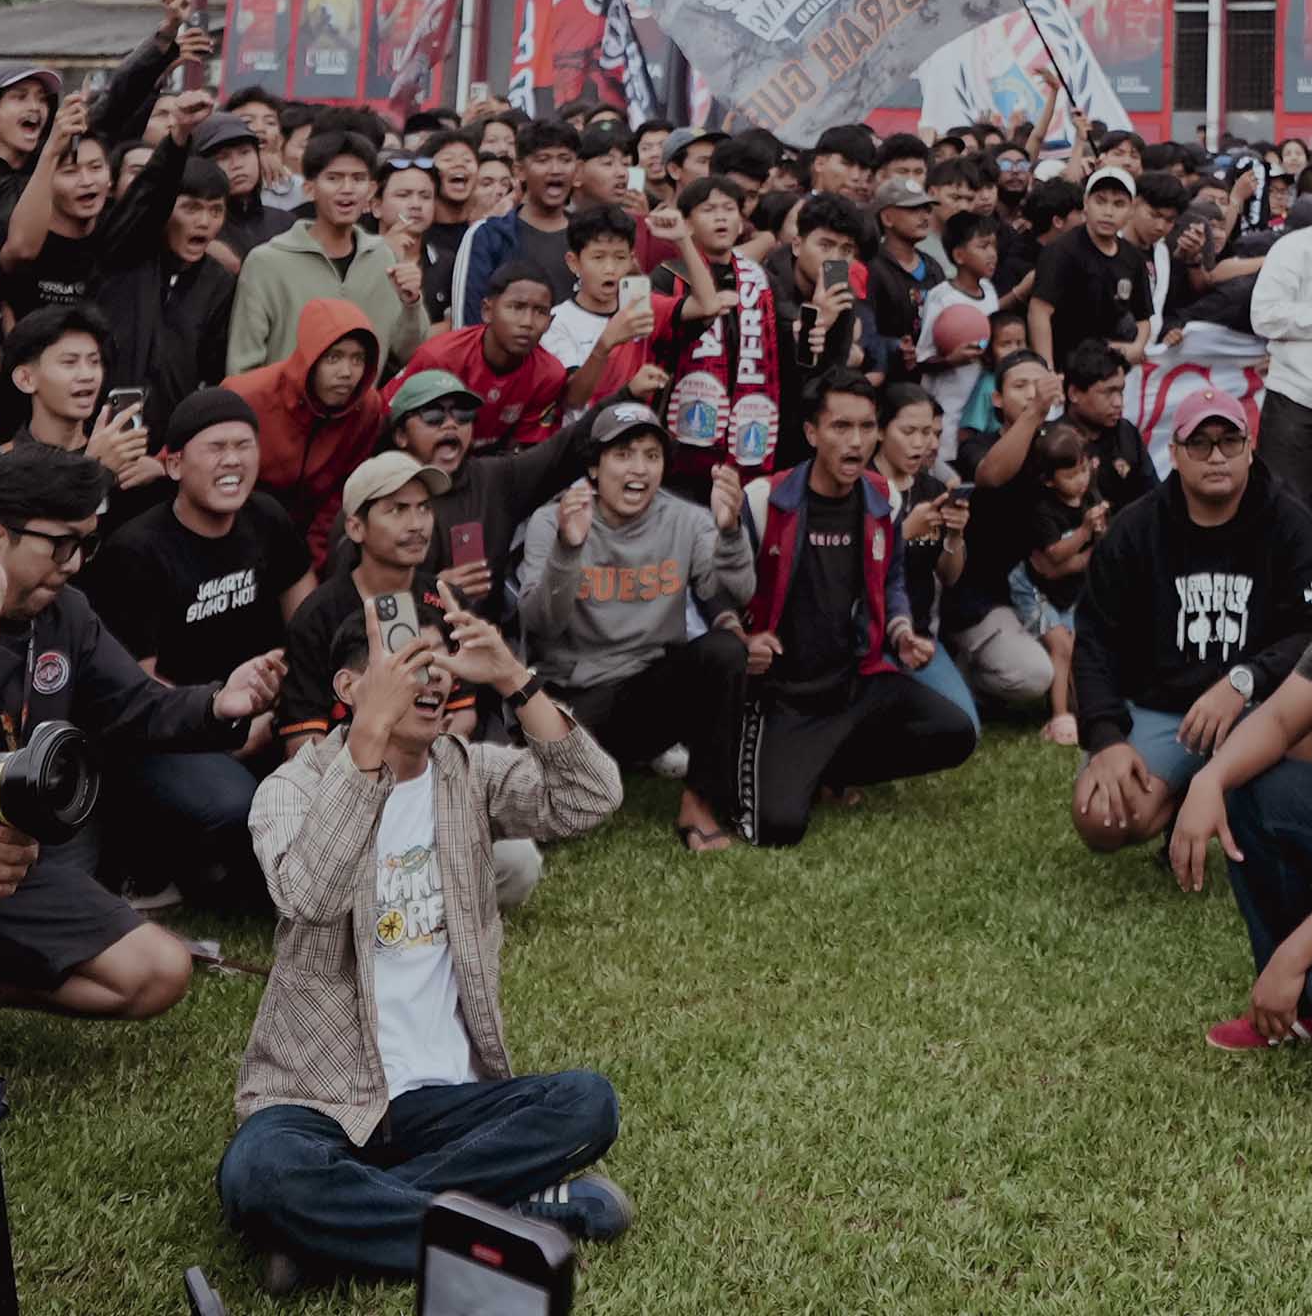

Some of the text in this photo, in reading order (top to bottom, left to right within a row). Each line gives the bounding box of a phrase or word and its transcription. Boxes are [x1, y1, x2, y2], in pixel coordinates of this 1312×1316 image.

[196, 568, 256, 602] JAKARTA
[186, 585, 257, 623] SIAMO NOI
